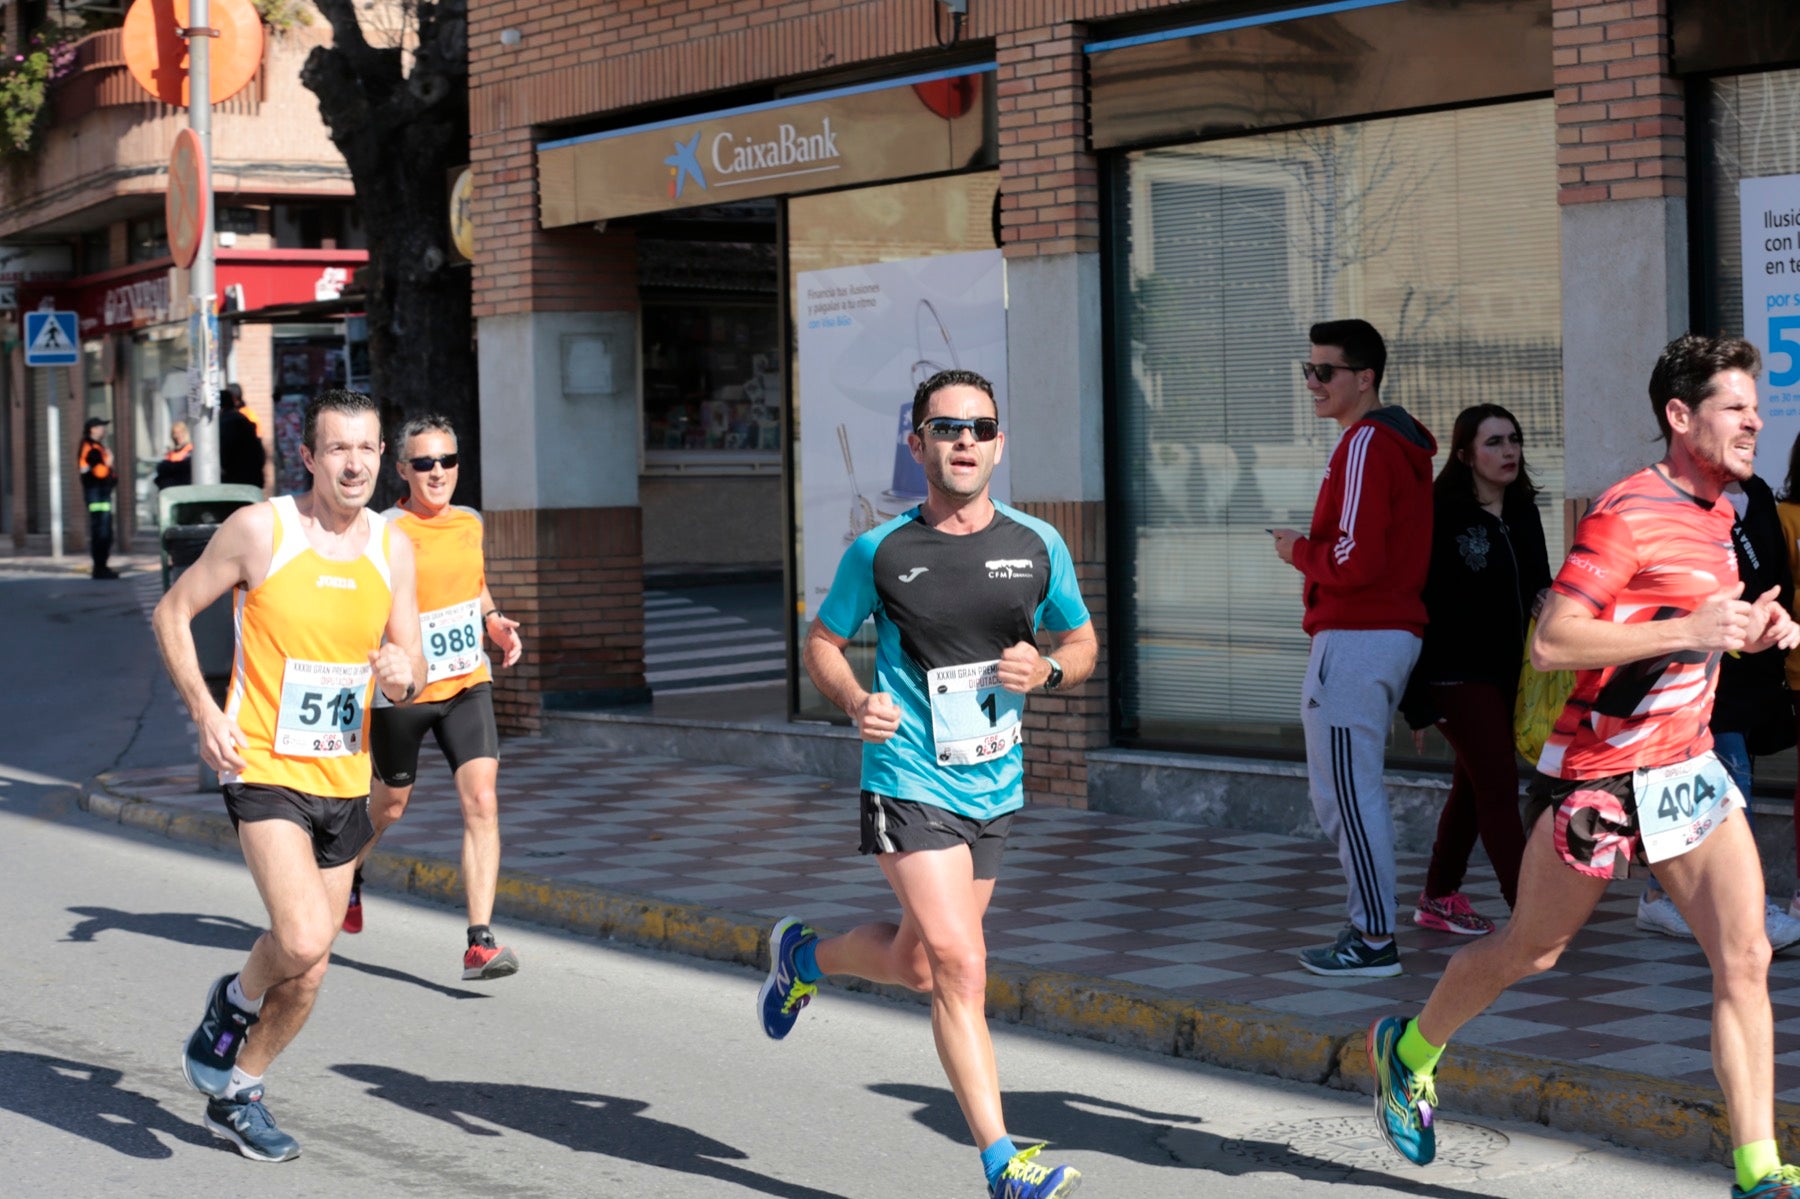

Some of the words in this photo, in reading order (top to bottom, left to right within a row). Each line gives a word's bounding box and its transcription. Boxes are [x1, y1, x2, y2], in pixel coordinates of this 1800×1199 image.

[712, 116, 840, 174] CaixaBank
[1765, 237, 1792, 251] con
[1766, 260, 1784, 275] en
[1766, 293, 1790, 311] por
[430, 624, 475, 657] 988
[958, 668, 977, 679] GRAN
[299, 692, 356, 727] 515
[981, 693, 997, 728] 1
[1657, 774, 1715, 822] 404
